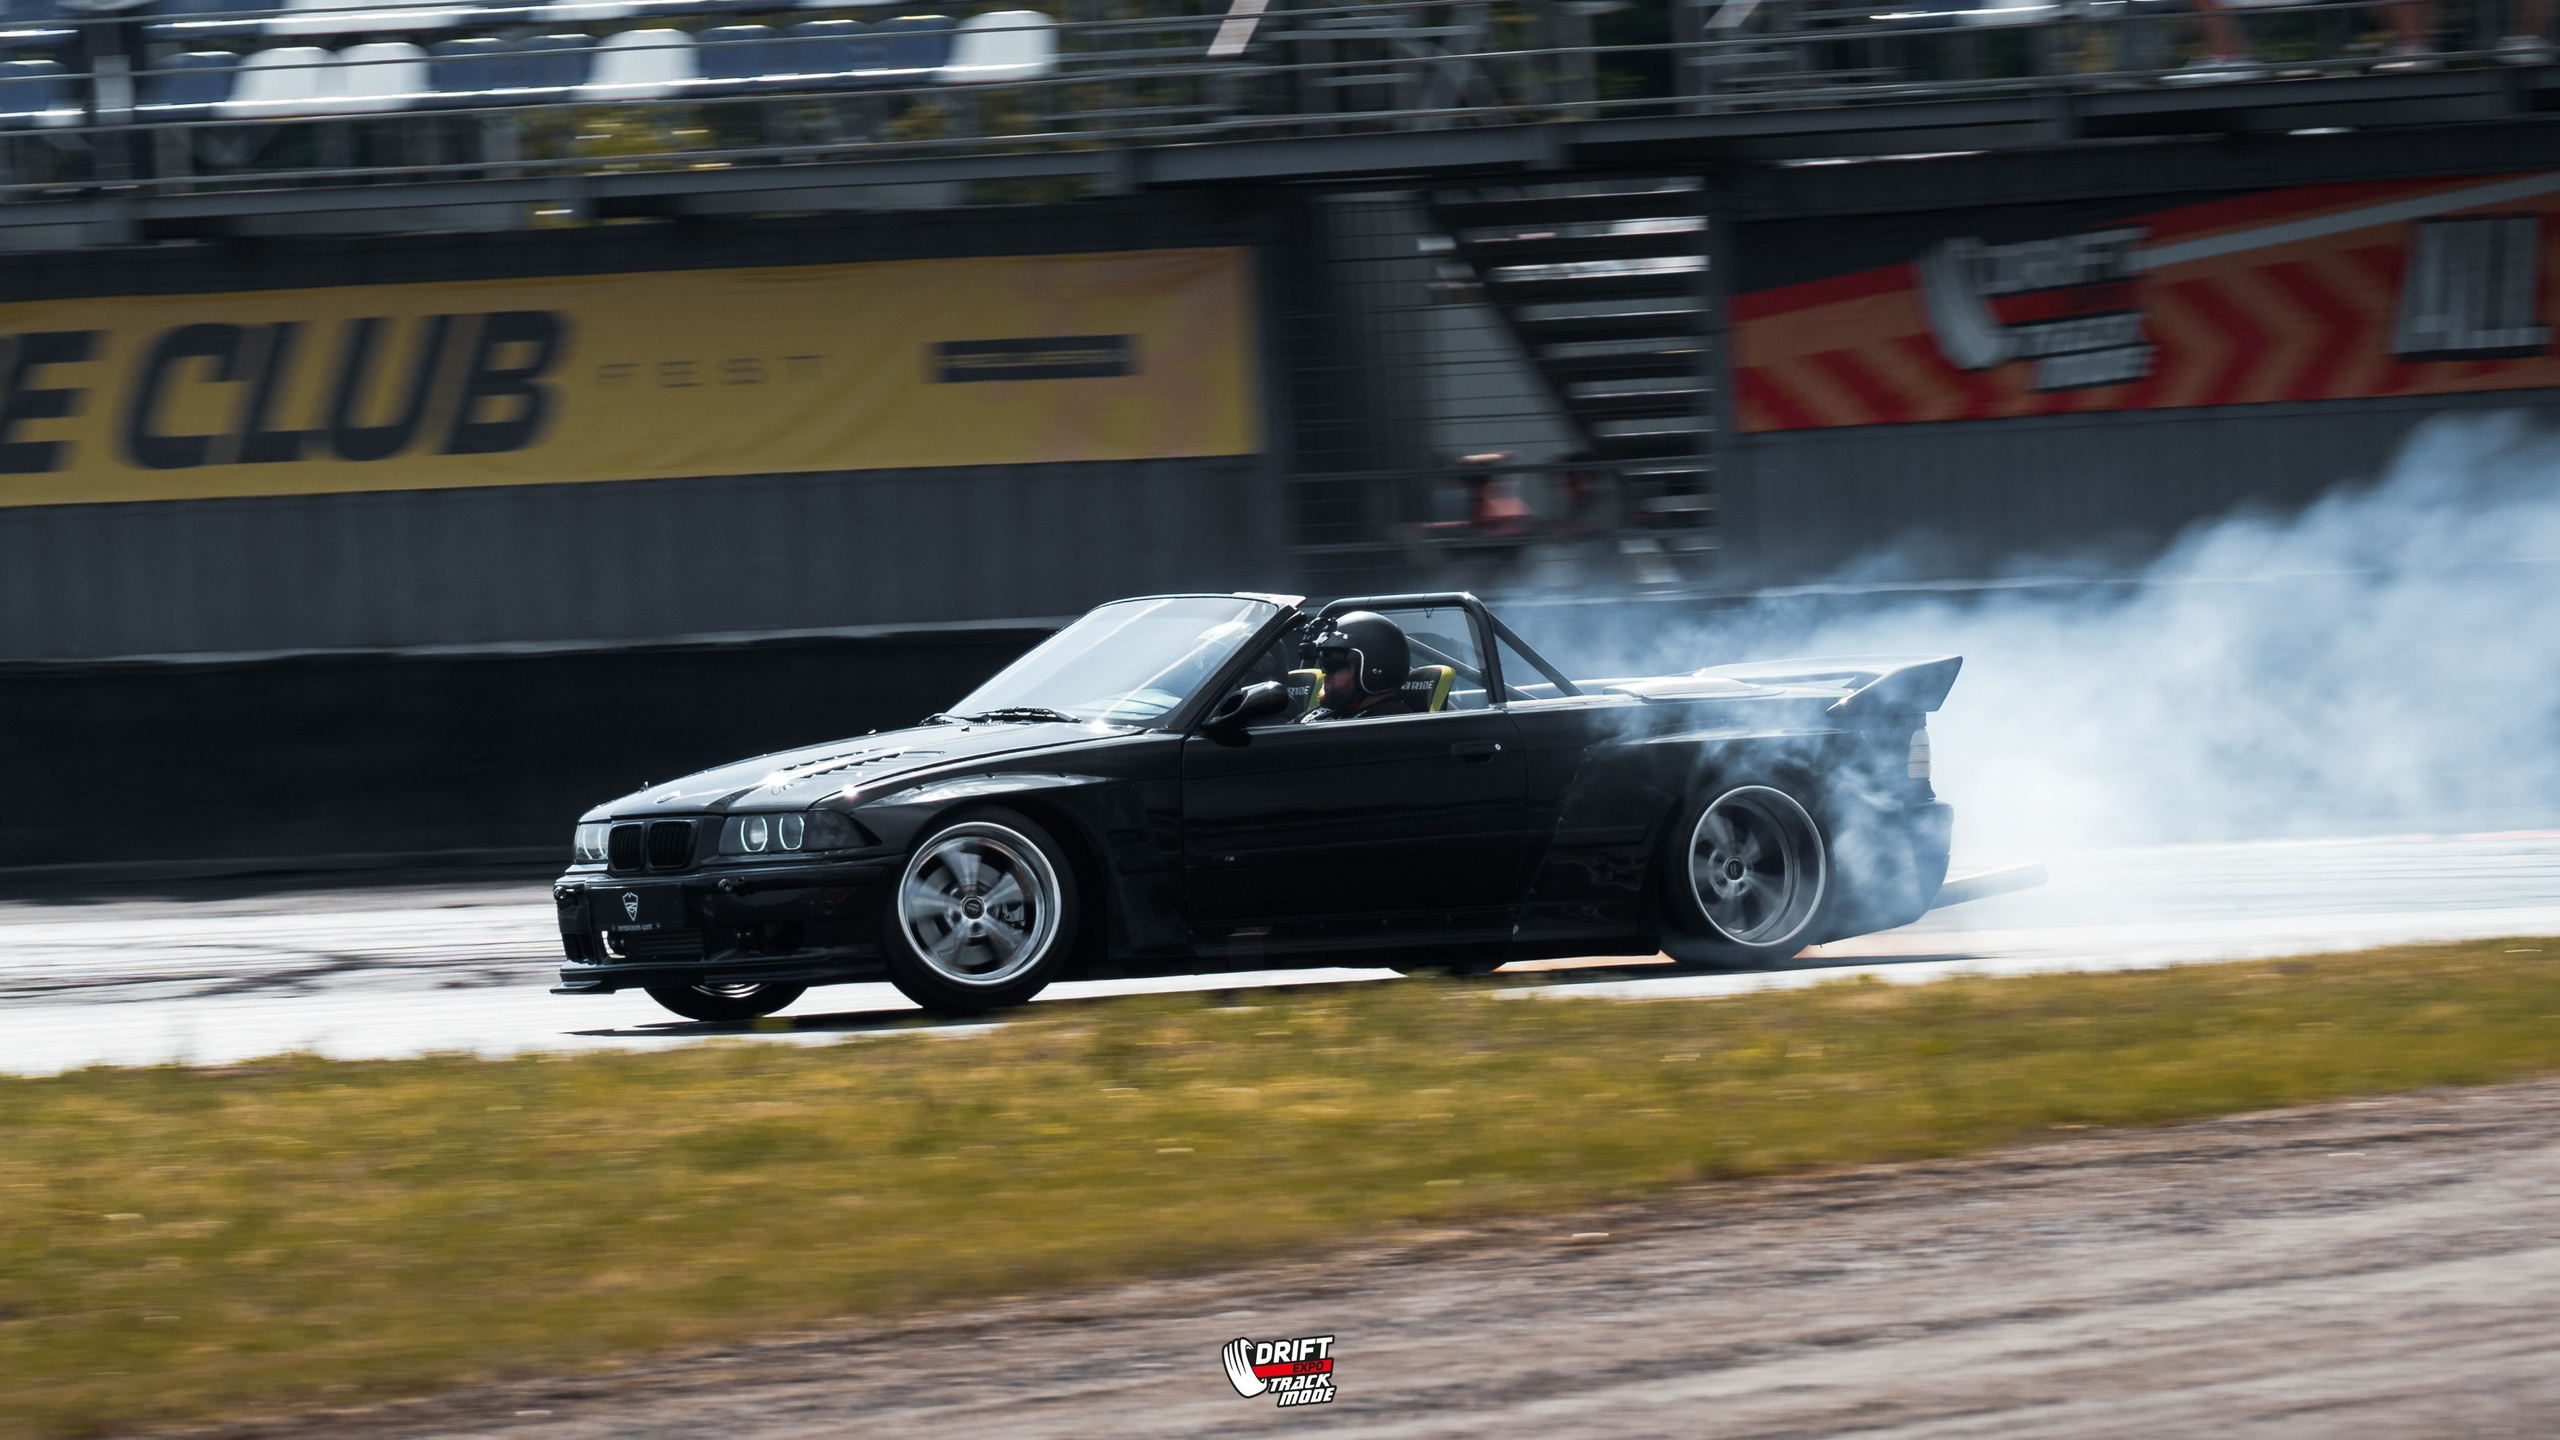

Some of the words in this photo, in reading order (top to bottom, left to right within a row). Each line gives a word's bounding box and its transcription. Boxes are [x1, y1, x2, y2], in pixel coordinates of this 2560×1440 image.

[597, 354, 828, 389] FEST
[120, 309, 575, 471] CLUB
[1287, 685, 1310, 696] RIDE
